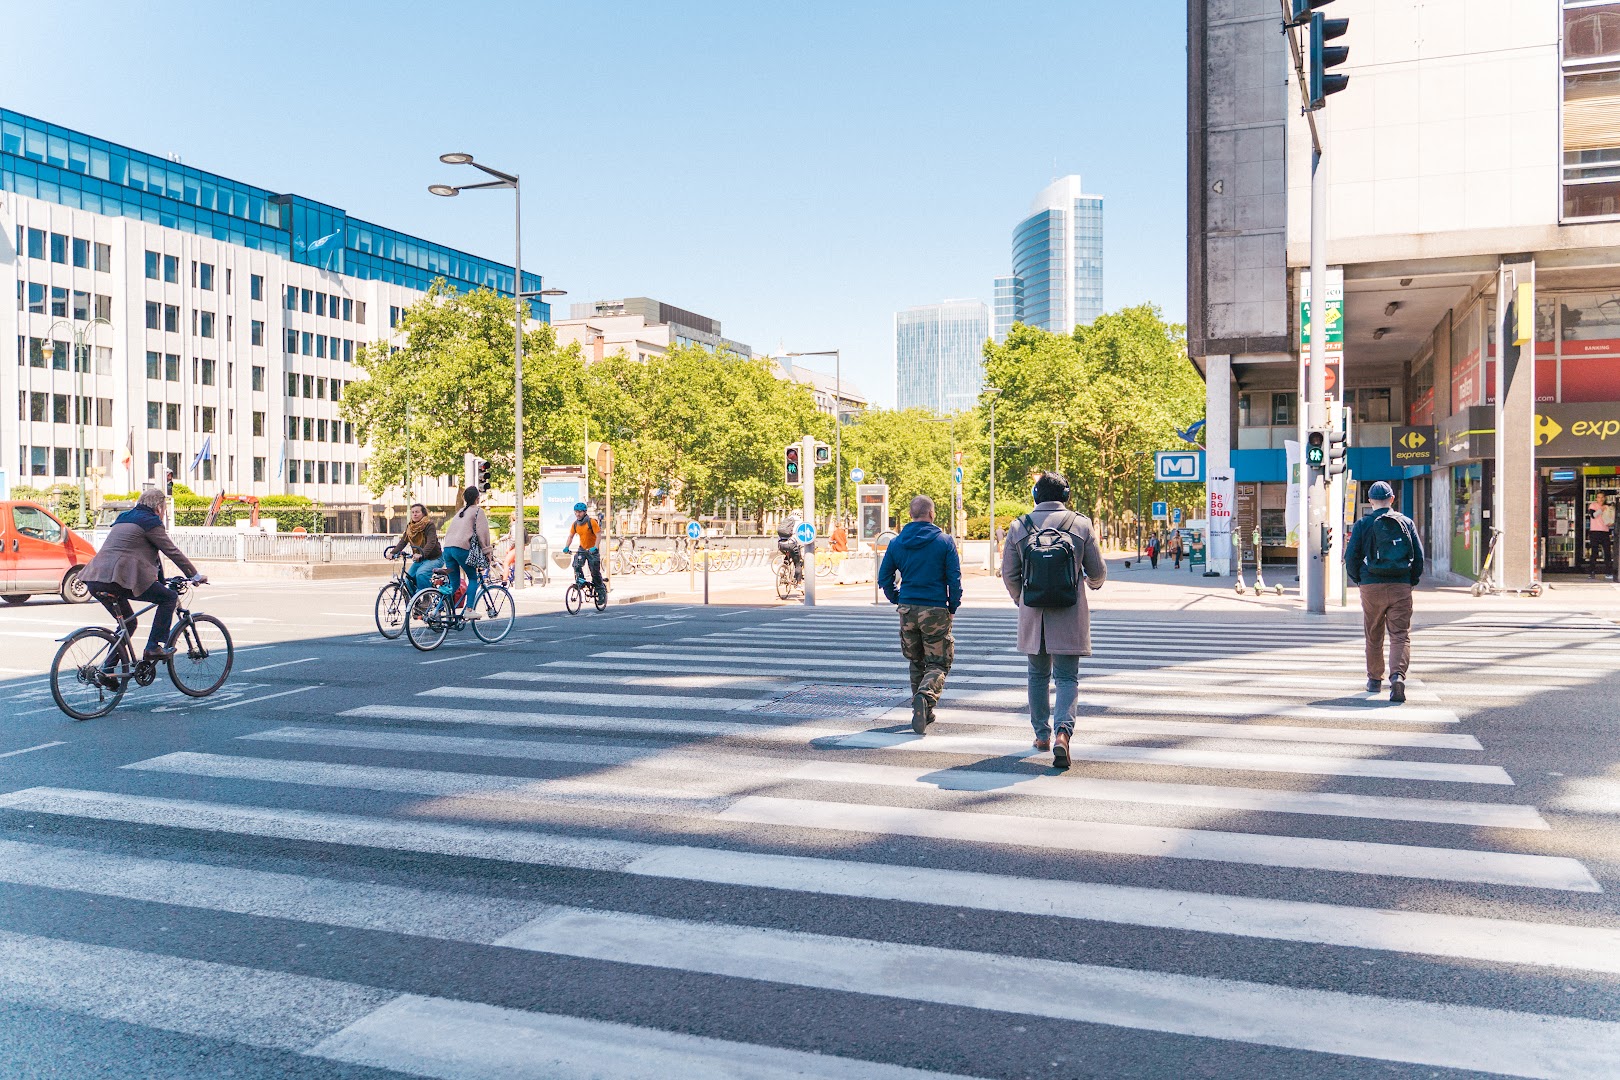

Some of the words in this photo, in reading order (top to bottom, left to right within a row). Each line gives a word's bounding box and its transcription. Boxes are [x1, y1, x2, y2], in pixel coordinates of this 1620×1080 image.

[1571, 420, 1620, 440] exp
[1396, 450, 1430, 460] express
[1163, 458, 1193, 475] M
[1211, 492, 1223, 500] Be
